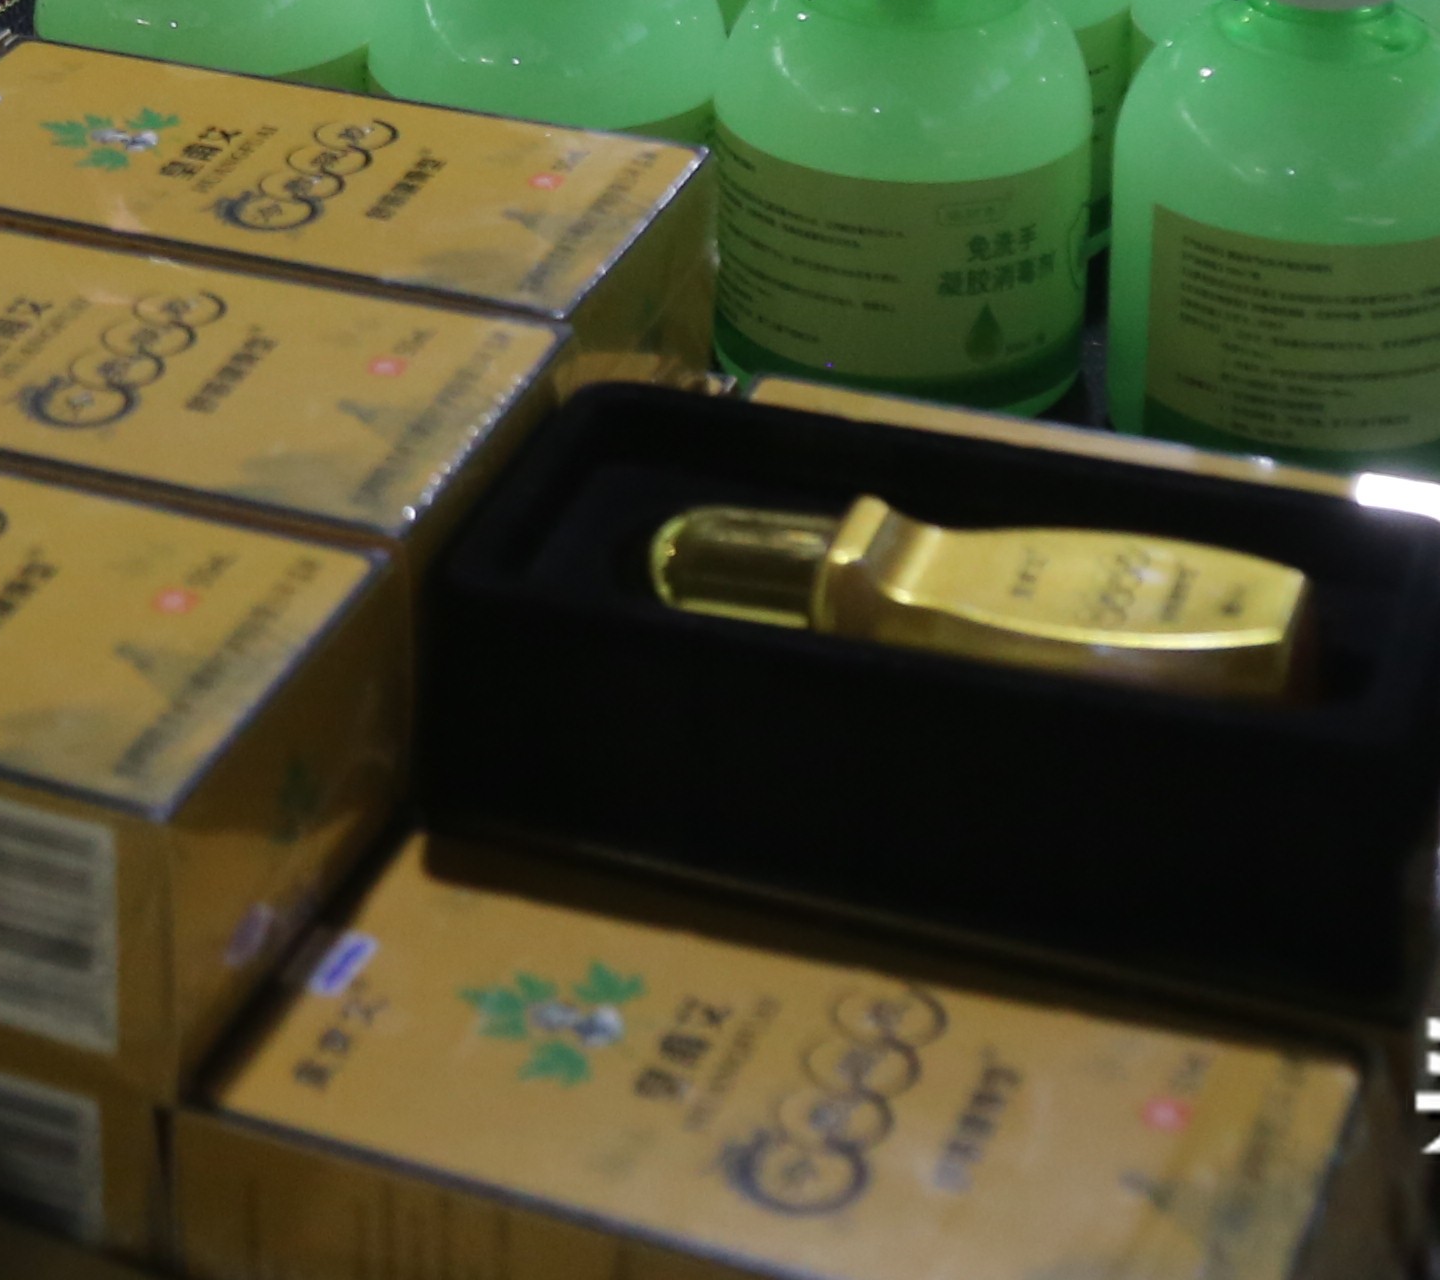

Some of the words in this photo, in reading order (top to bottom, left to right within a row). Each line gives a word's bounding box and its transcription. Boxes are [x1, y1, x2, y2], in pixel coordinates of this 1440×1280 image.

[967, 223, 1038, 261] 免洗手
[937, 251, 1057, 297] 凝胶消毒剂
